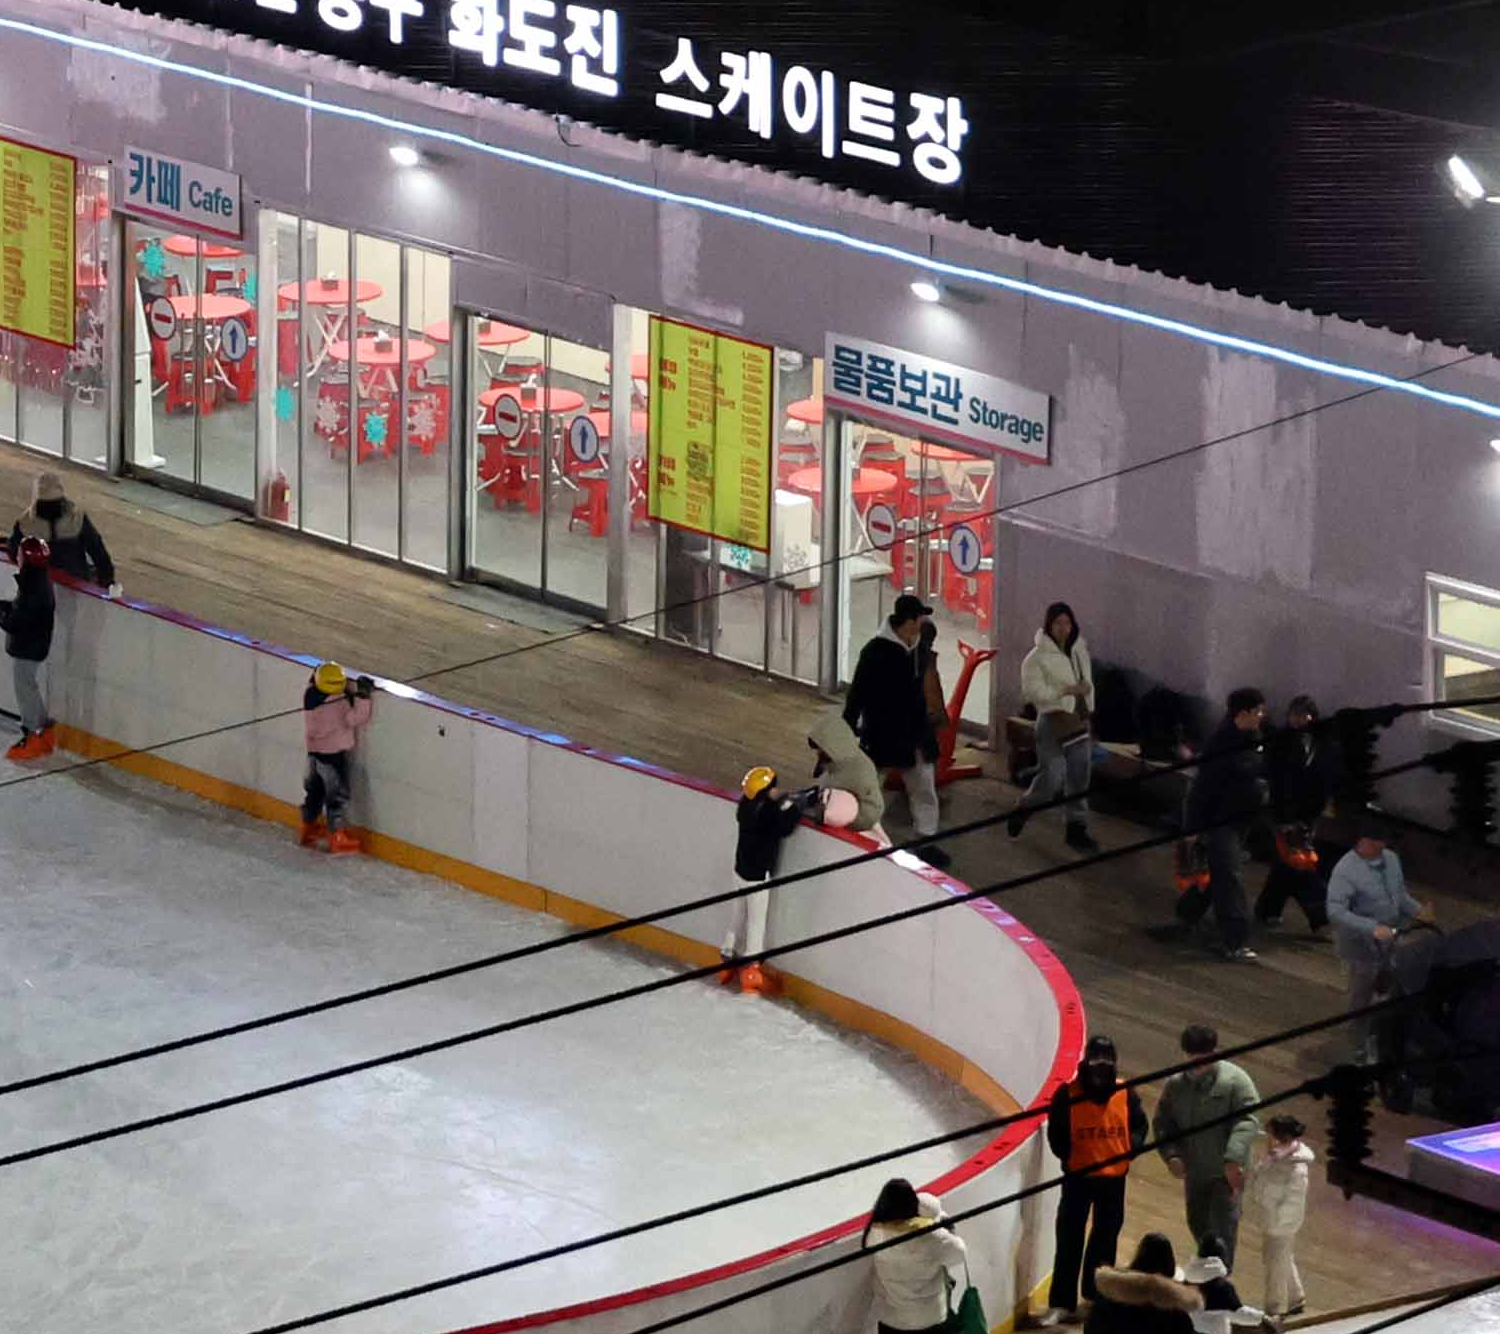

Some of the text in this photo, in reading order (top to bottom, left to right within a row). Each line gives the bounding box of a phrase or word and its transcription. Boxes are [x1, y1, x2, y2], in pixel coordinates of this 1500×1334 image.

[655, 37, 969, 184] 스케이트장
[129, 152, 233, 217] 카페 Cafe
[832, 344, 963, 426] 물품보관
[968, 396, 1045, 444] Storage
